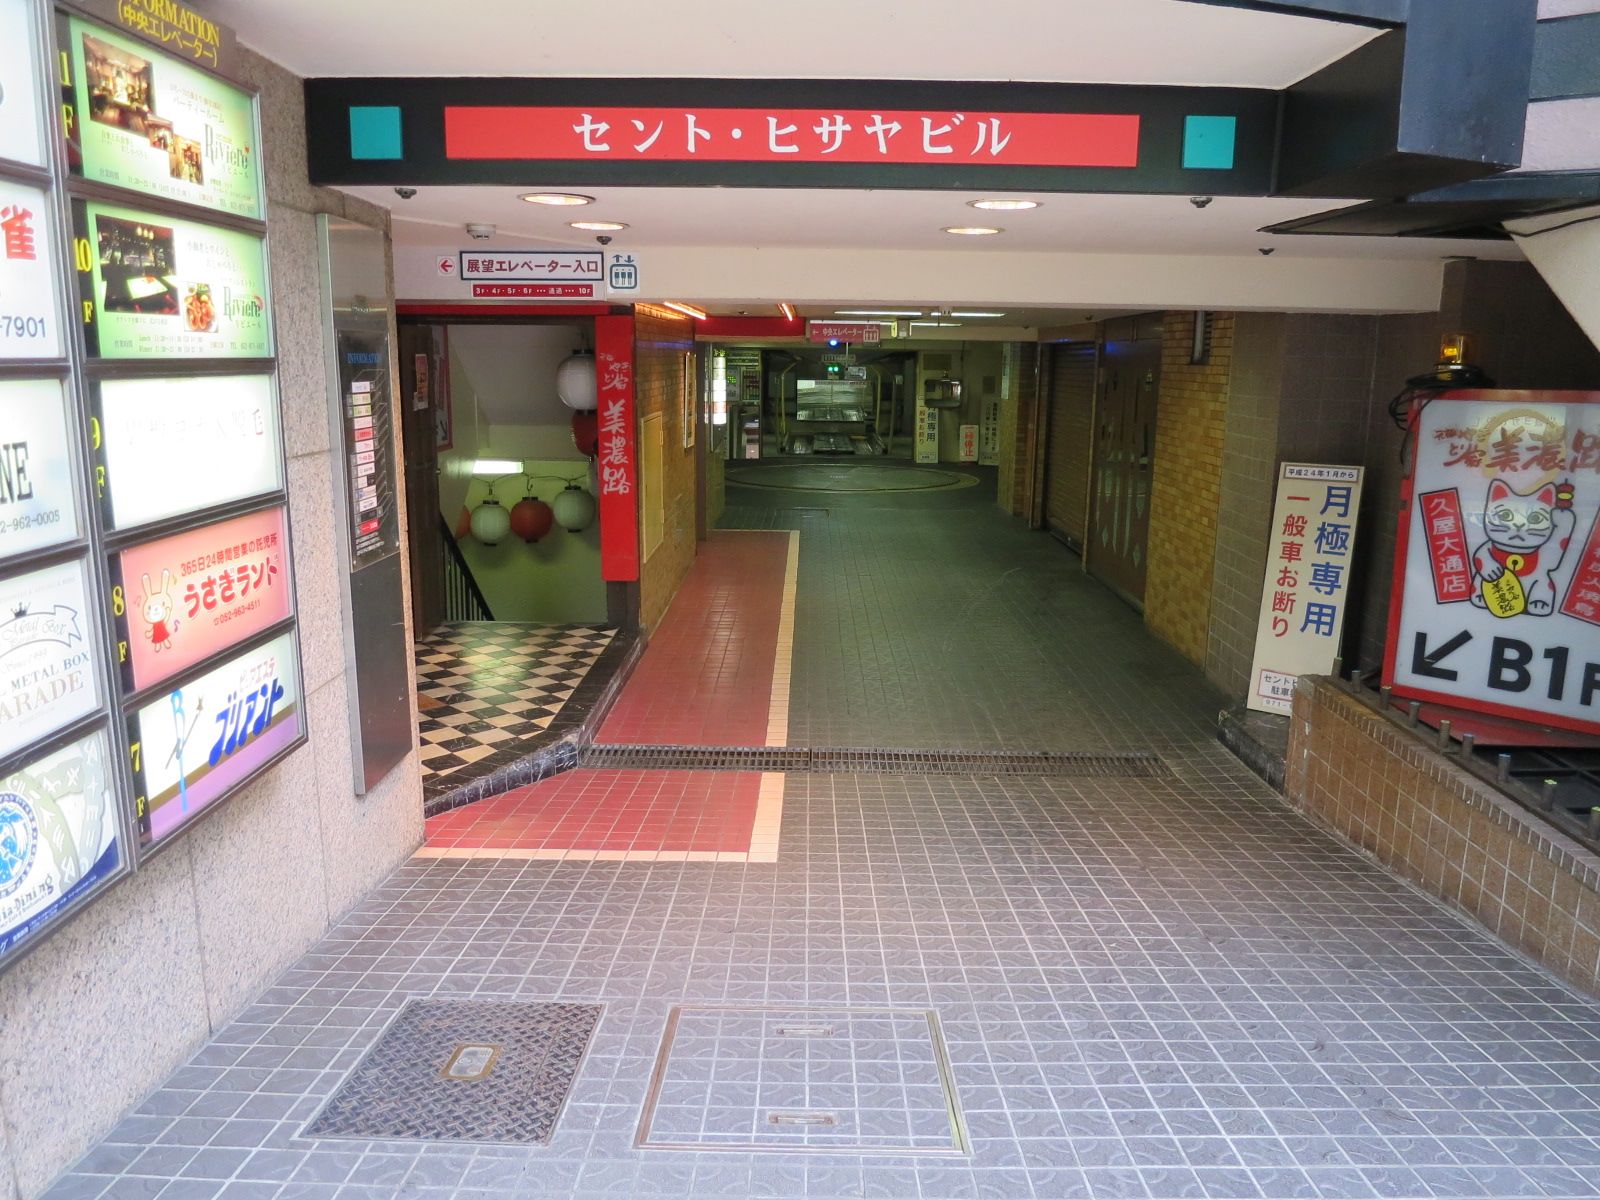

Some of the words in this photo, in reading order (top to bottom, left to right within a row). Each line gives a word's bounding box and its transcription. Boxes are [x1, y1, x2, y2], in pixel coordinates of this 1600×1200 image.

[572, 112, 1012, 157] セント・ヒサヤビル
[1, 204, 37, 261] 雀
[73, 237, 93, 273] 10
[466, 258, 599, 274] 展望エレベーター入口
[181, 533, 278, 577] 365日24時間営業の託児所
[1271, 495, 1311, 638] 一般車お断り
[1300, 485, 1353, 637] 月極専用
[1431, 497, 1467, 594] 久屋大通店
[112, 586, 125, 616] 8
[11, 664, 60, 690] METAL
[63, 651, 91, 670] BOX
[118, 640, 128, 663] F
[130, 742, 141, 773] 7
[136, 796, 146, 818] F
